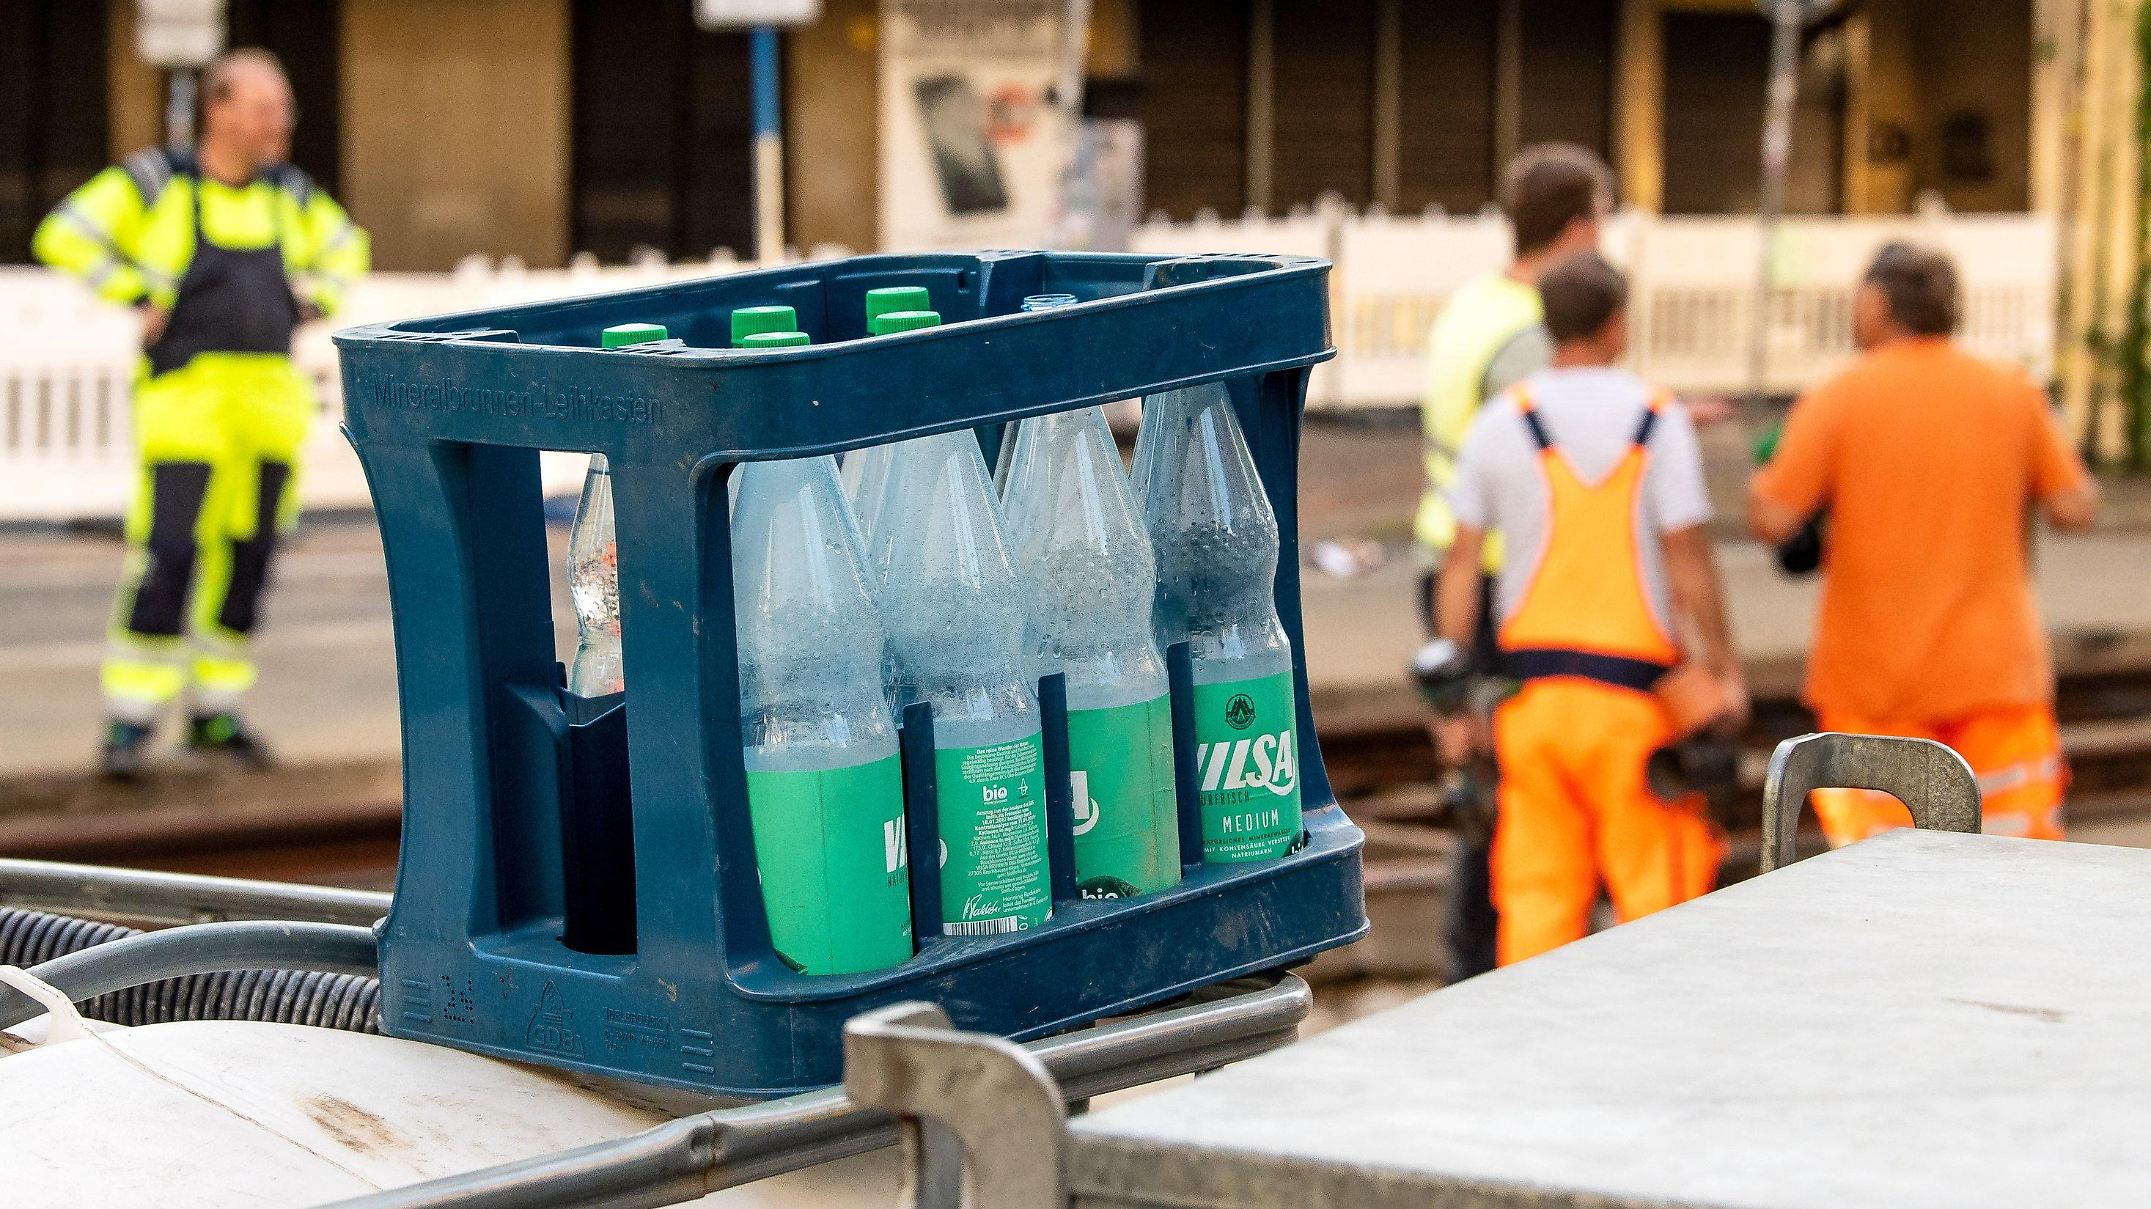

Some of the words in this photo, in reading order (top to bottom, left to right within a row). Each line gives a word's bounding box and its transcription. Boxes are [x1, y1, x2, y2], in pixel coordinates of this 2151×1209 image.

[372, 374, 664, 424] Mineralbrunnen-Leihkasten
[982, 784, 1008, 802] bio
[1222, 808, 1279, 834] MEDIUM
[1219, 841, 1265, 853] KOHLENSÄURE
[1231, 847, 1273, 859] NATRIUMARM
